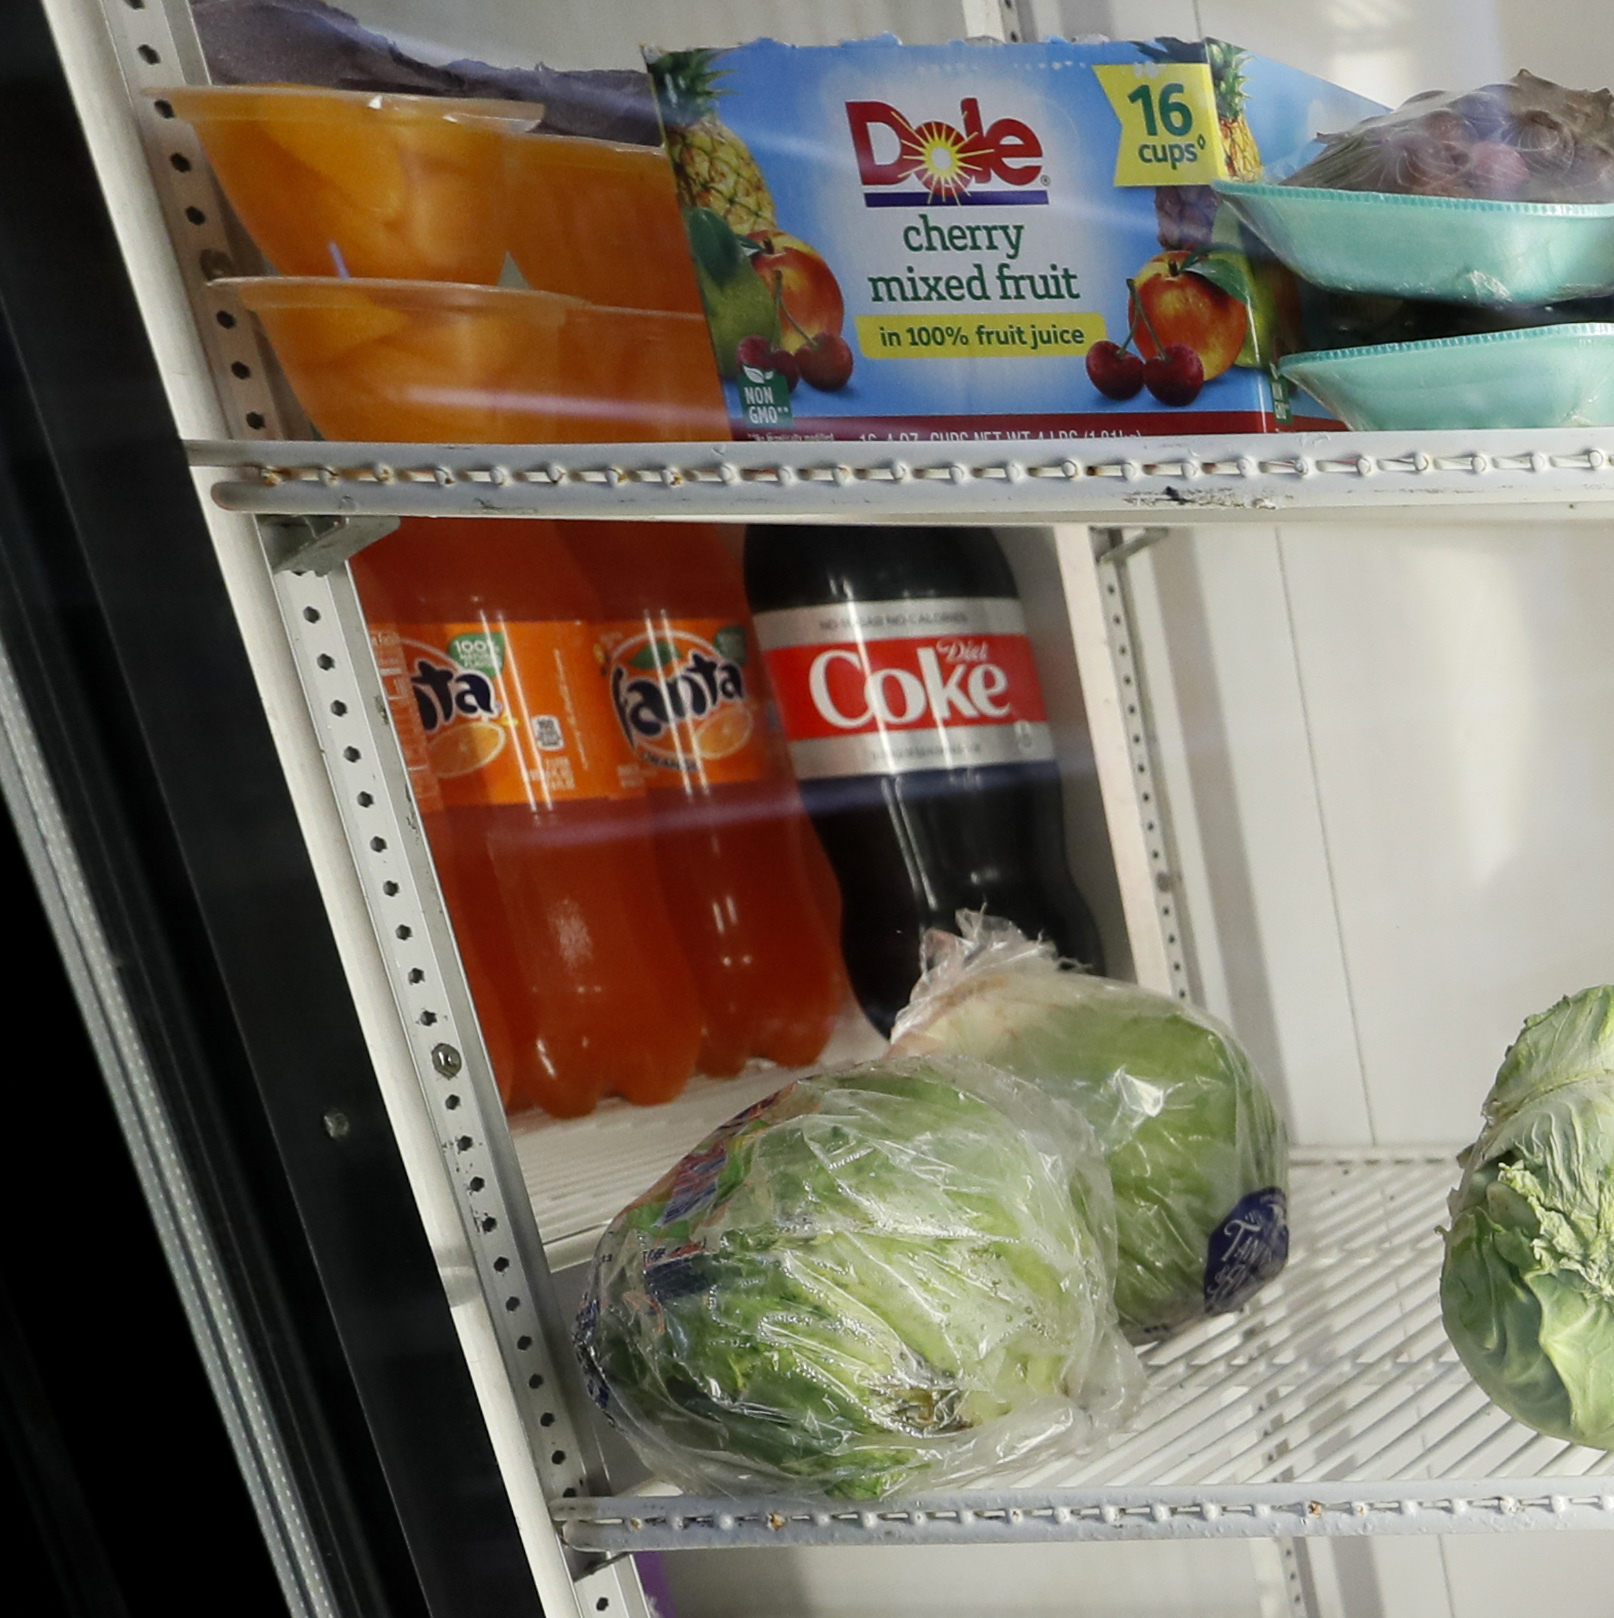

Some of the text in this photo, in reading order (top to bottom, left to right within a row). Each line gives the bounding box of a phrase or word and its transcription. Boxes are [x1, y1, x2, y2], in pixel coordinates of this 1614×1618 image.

[1127, 83, 1193, 138] 16
[845, 98, 1044, 197] Dole
[904, 214, 1024, 259] cherry
[868, 262, 1080, 303] mixed fruit
[880, 322, 1085, 350] in 100% fruit juice
[744, 387, 775, 405] NON
[936, 639, 990, 663] Diet
[611, 652, 745, 750] Fanta
[809, 647, 1012, 730] Coke
